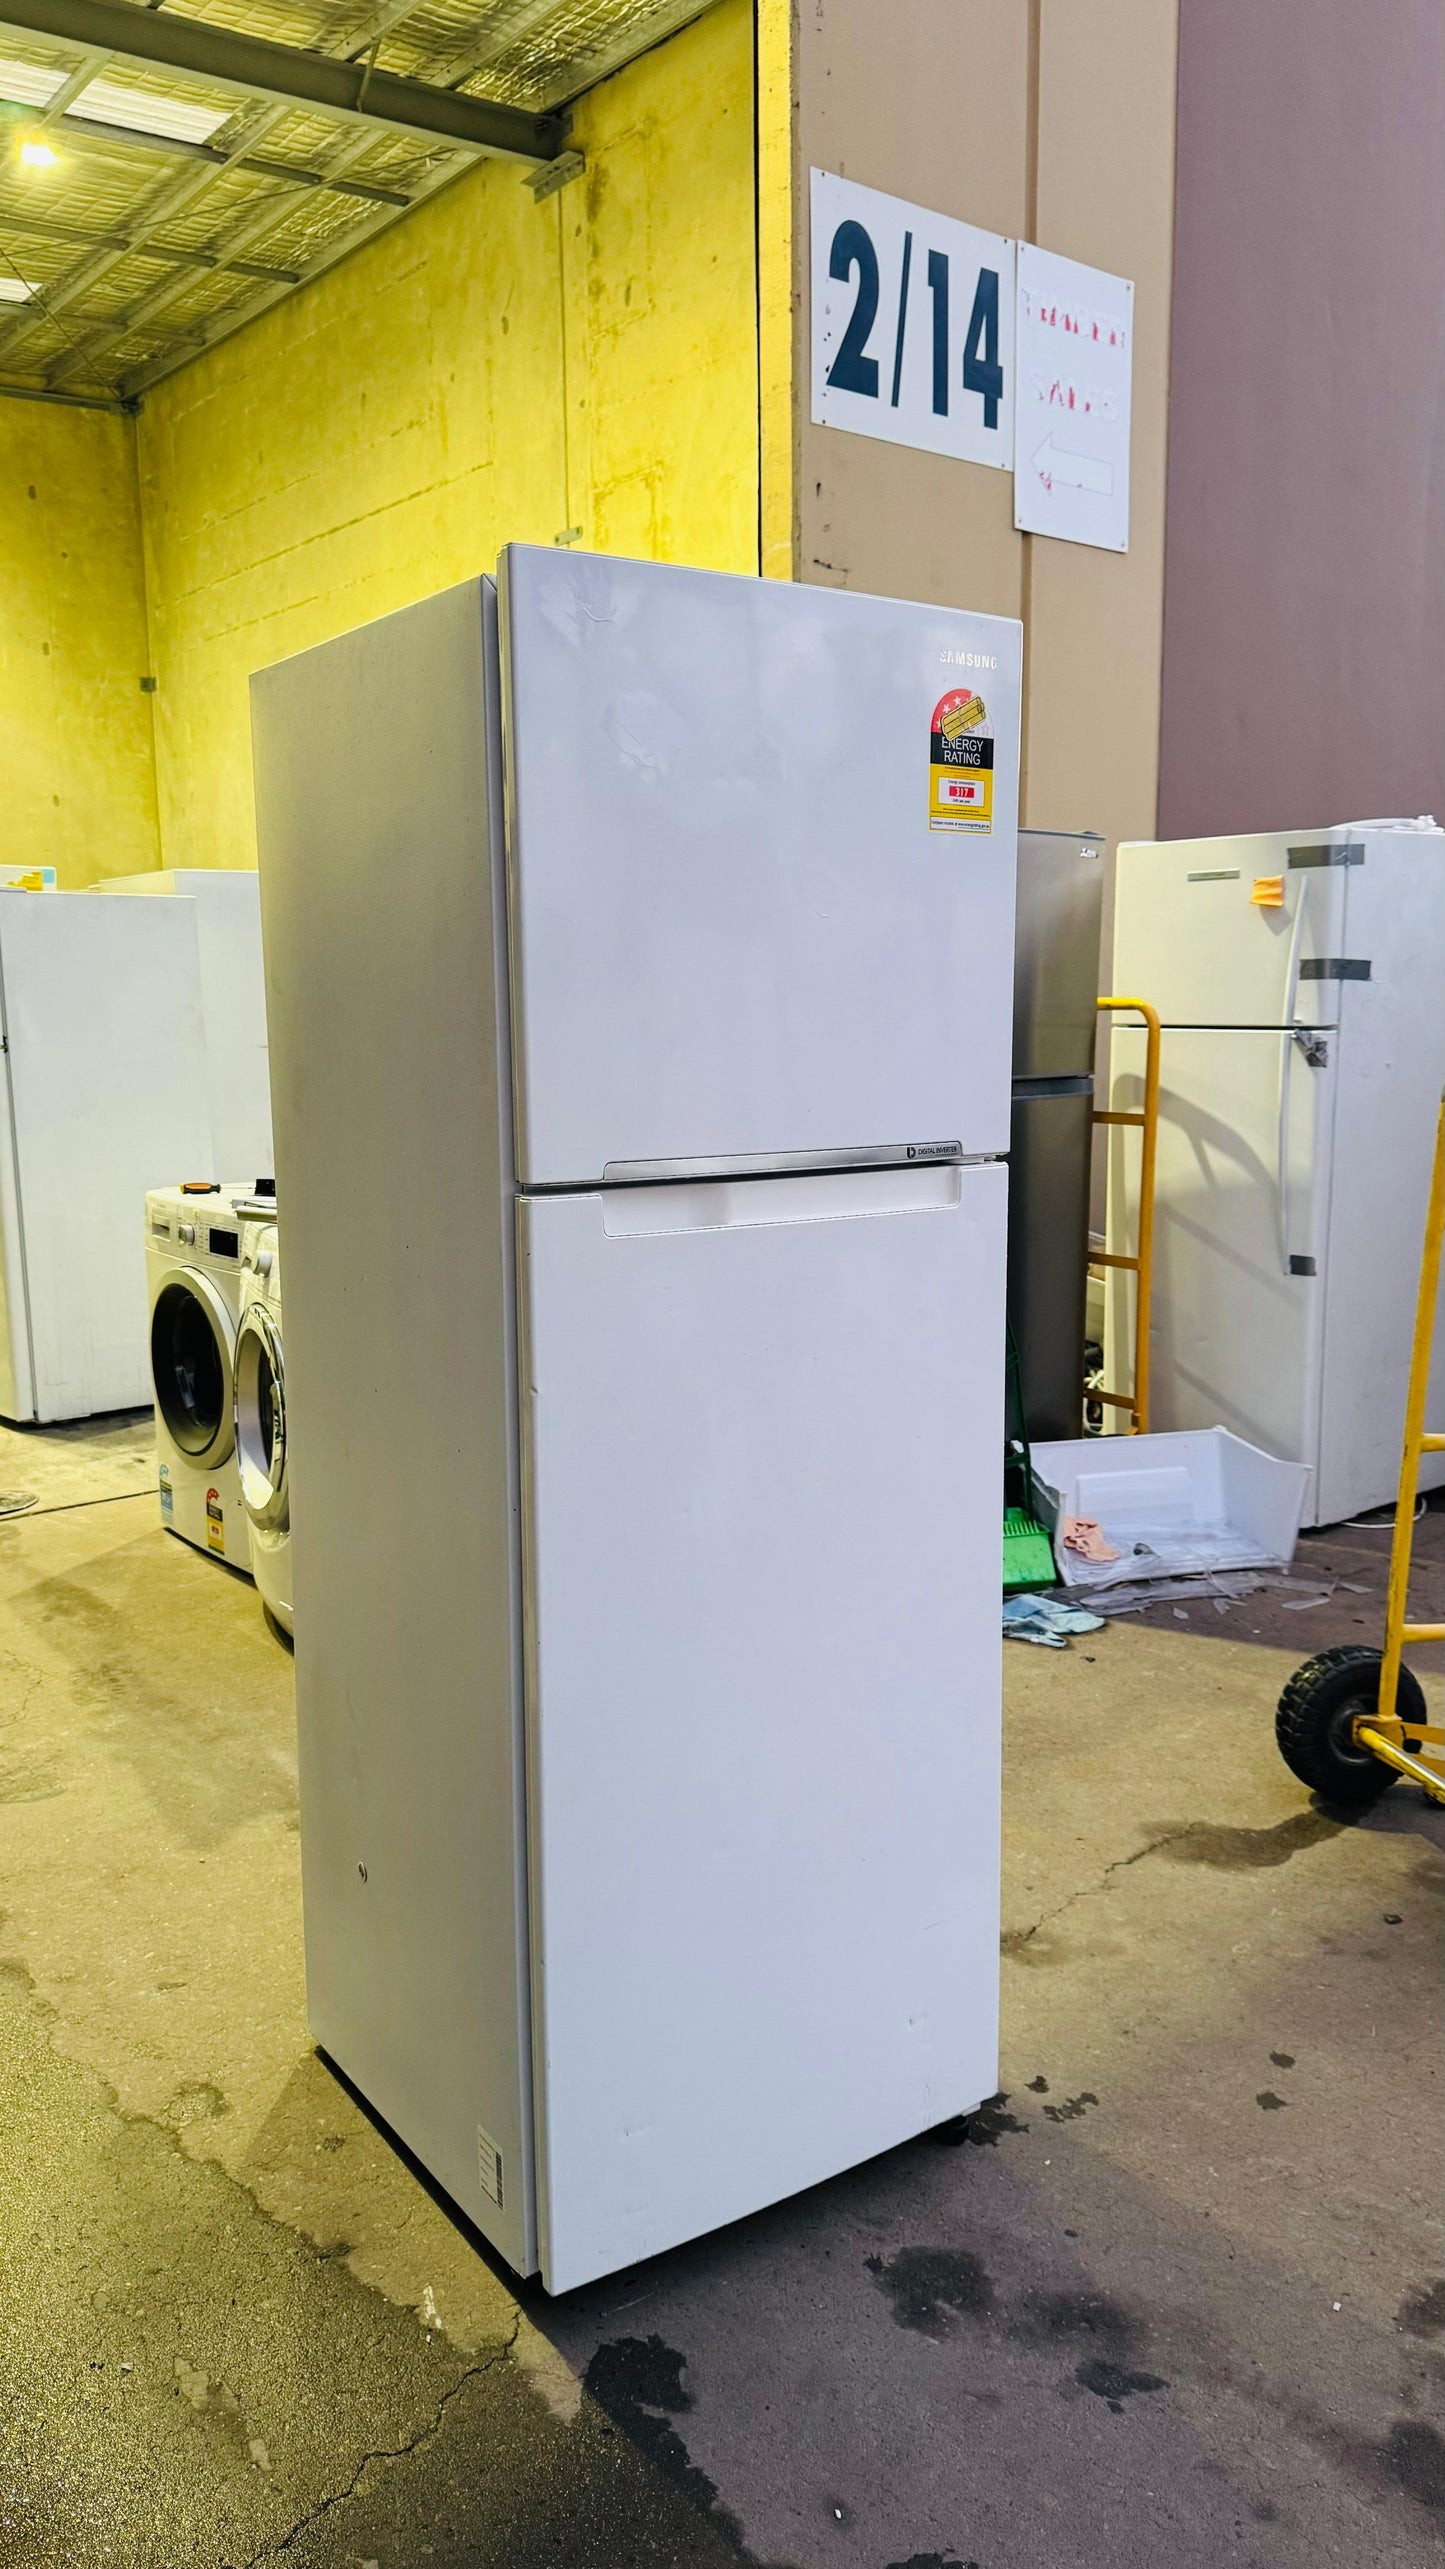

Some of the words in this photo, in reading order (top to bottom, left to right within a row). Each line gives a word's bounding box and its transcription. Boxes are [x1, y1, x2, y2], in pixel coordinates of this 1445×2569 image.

[826, 219, 1004, 431] 2/14
[939, 650, 998, 670] SAMSUNG
[941, 736, 984, 752] ENERGY
[944, 750, 981, 766] RATING
